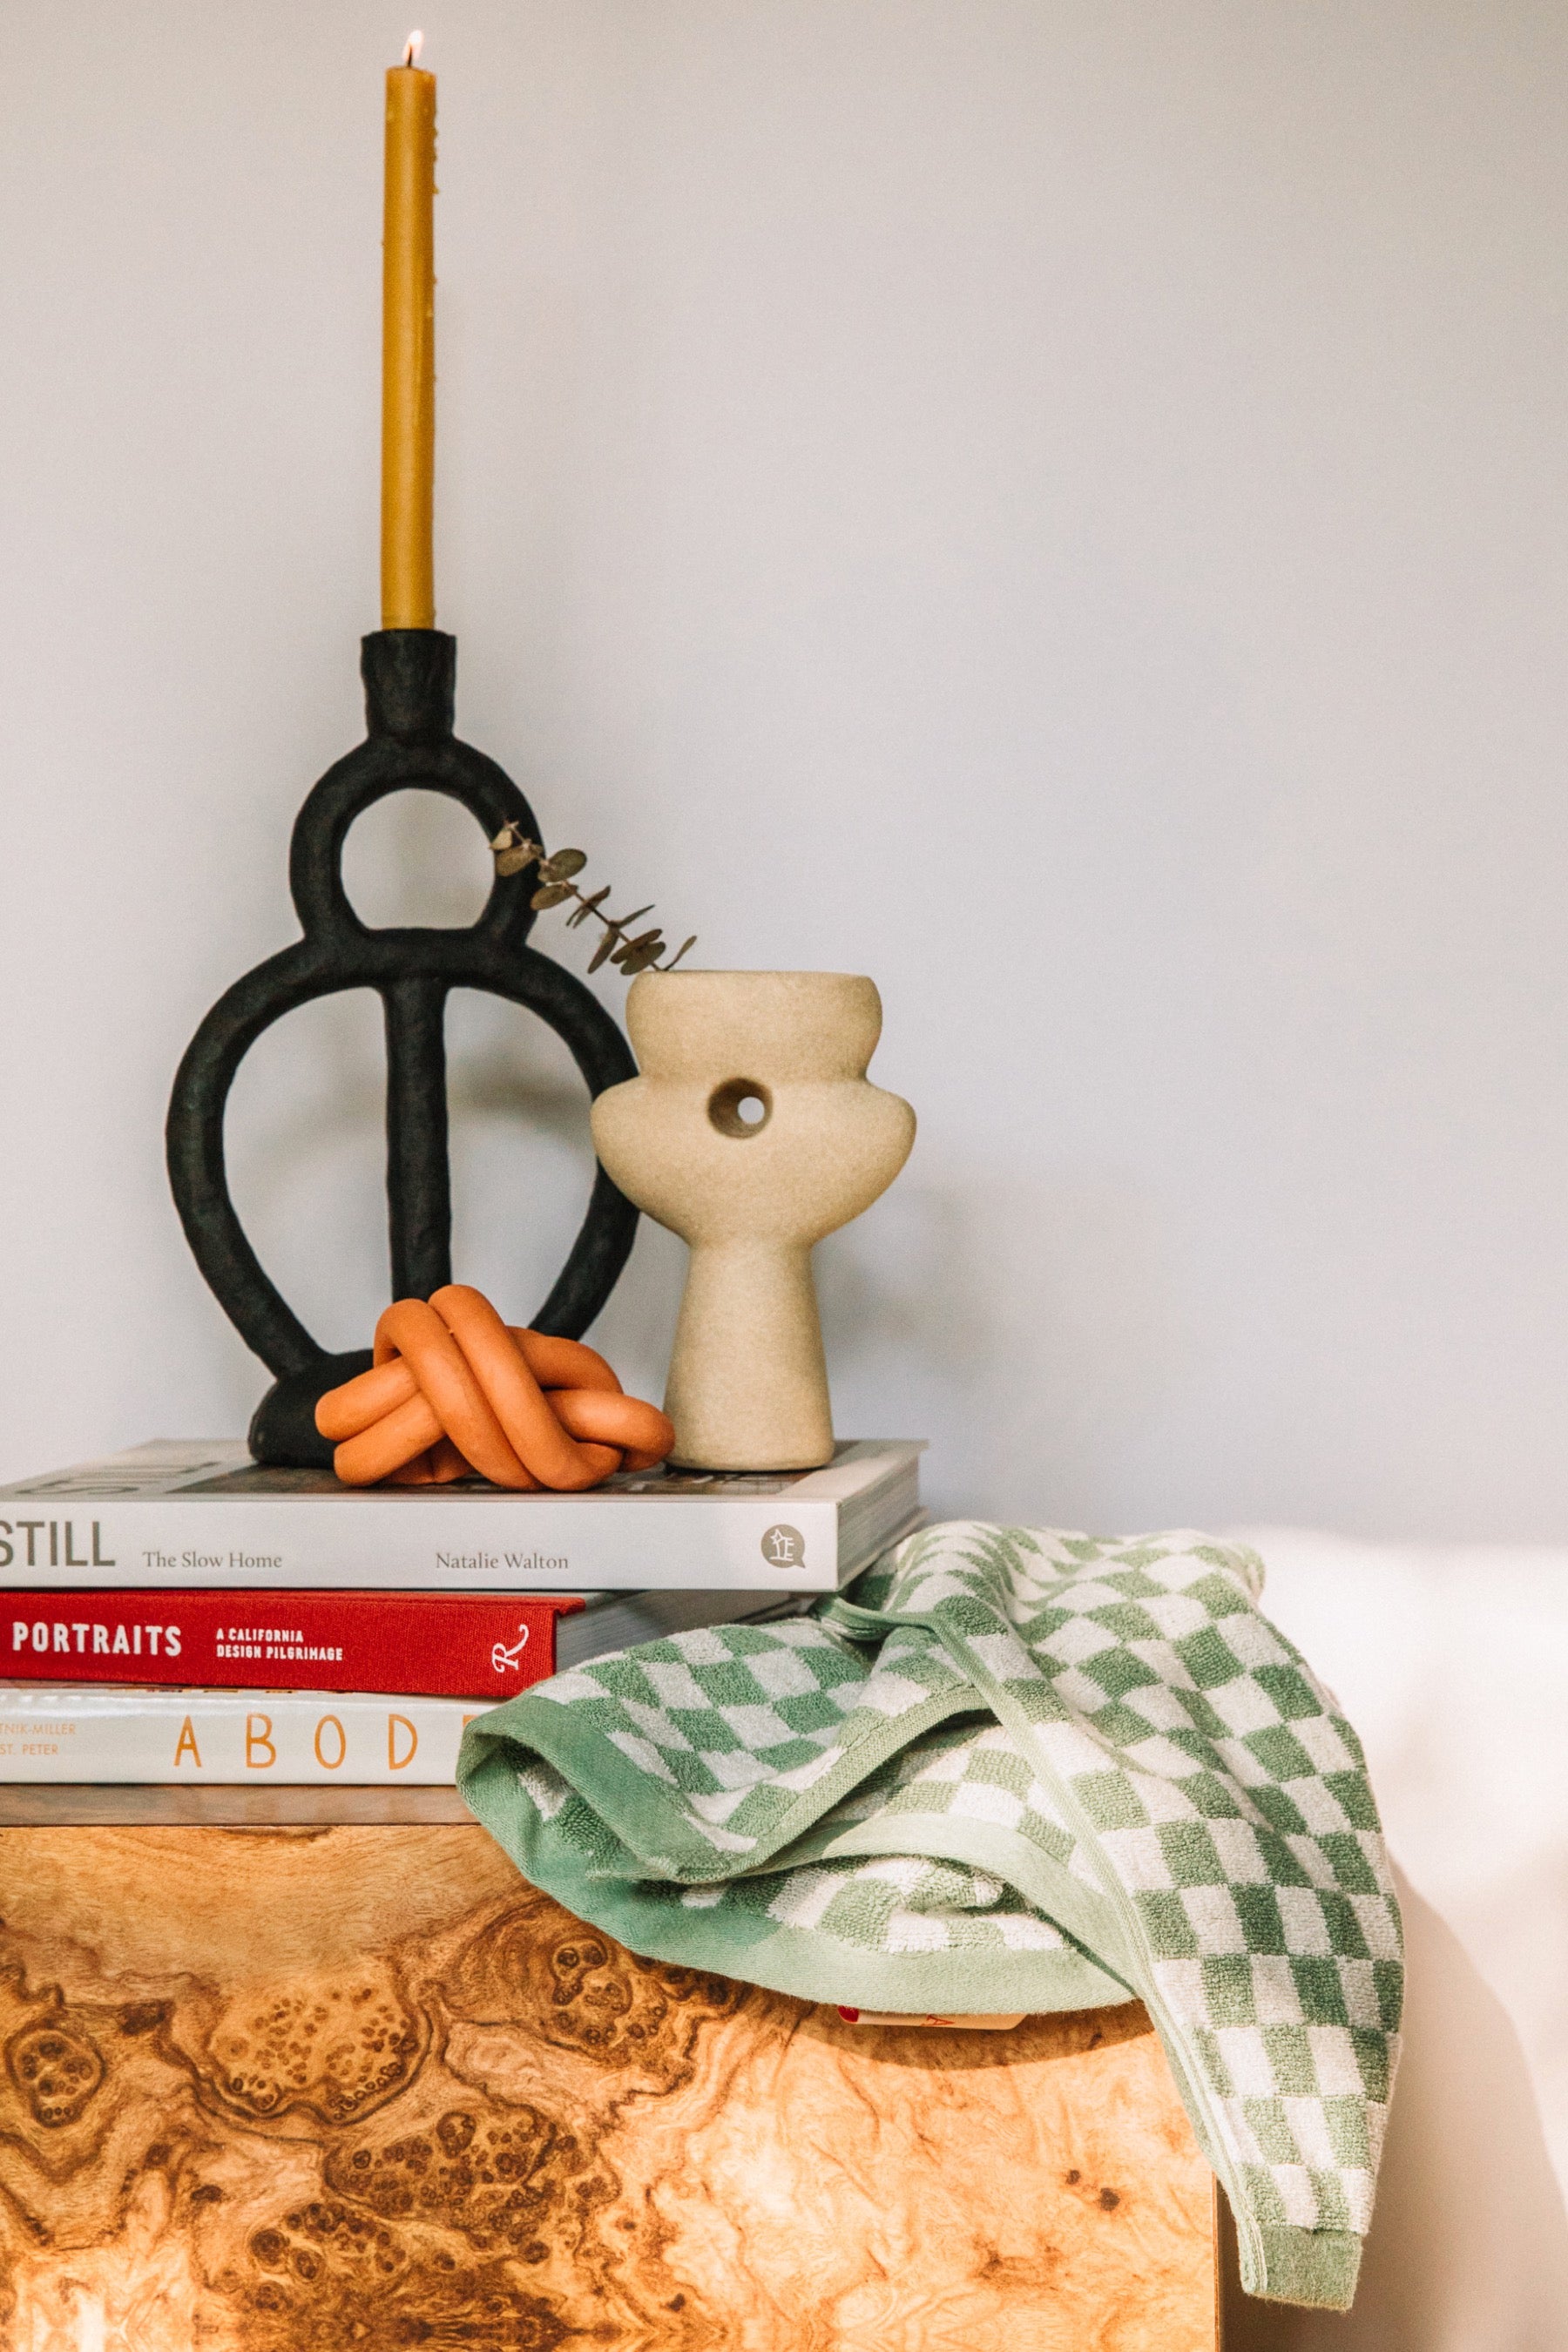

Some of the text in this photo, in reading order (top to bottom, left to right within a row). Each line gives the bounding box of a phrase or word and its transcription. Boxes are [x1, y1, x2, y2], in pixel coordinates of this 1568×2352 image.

[142, 1551, 282, 1568] The Slow Home
[436, 1551, 569, 1569] Natalie Walton
[12, 1621, 182, 1657] PORTRAITS
[216, 1627, 304, 1643] A CALIFORNIA
[216, 1645, 343, 1661] DESIGN PILGRIMAGE
[22, 1744, 59, 1756] PETER
[173, 1713, 479, 1770] ABOD
